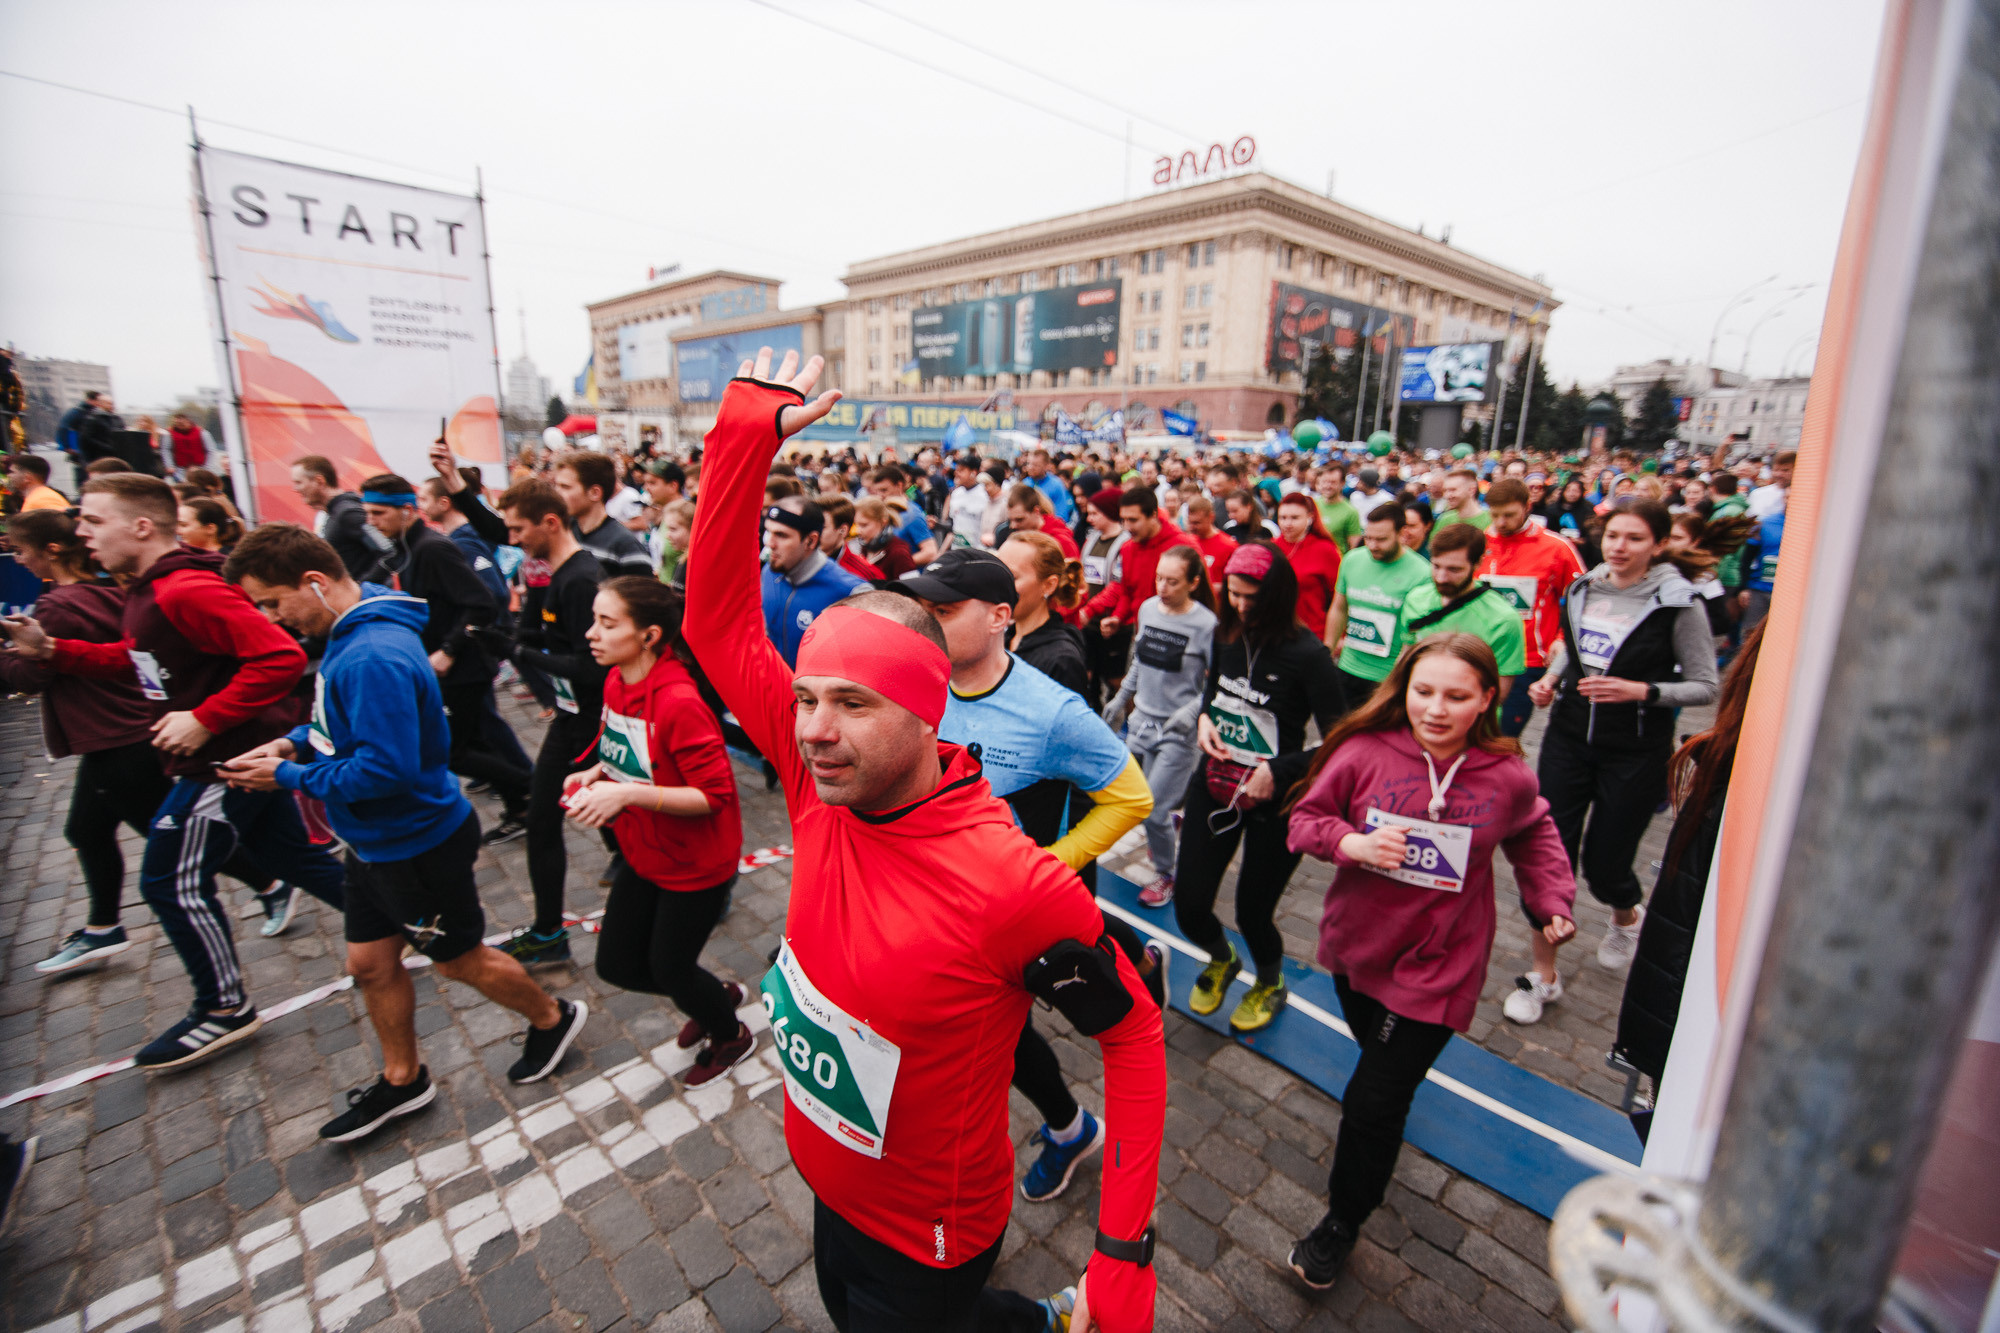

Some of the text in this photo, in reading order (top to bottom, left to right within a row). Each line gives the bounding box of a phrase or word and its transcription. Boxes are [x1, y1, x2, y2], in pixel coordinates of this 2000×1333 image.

[230, 184, 467, 257] START
[814, 403, 857, 427] СЕ
[933, 1223, 946, 1262] Reebok
